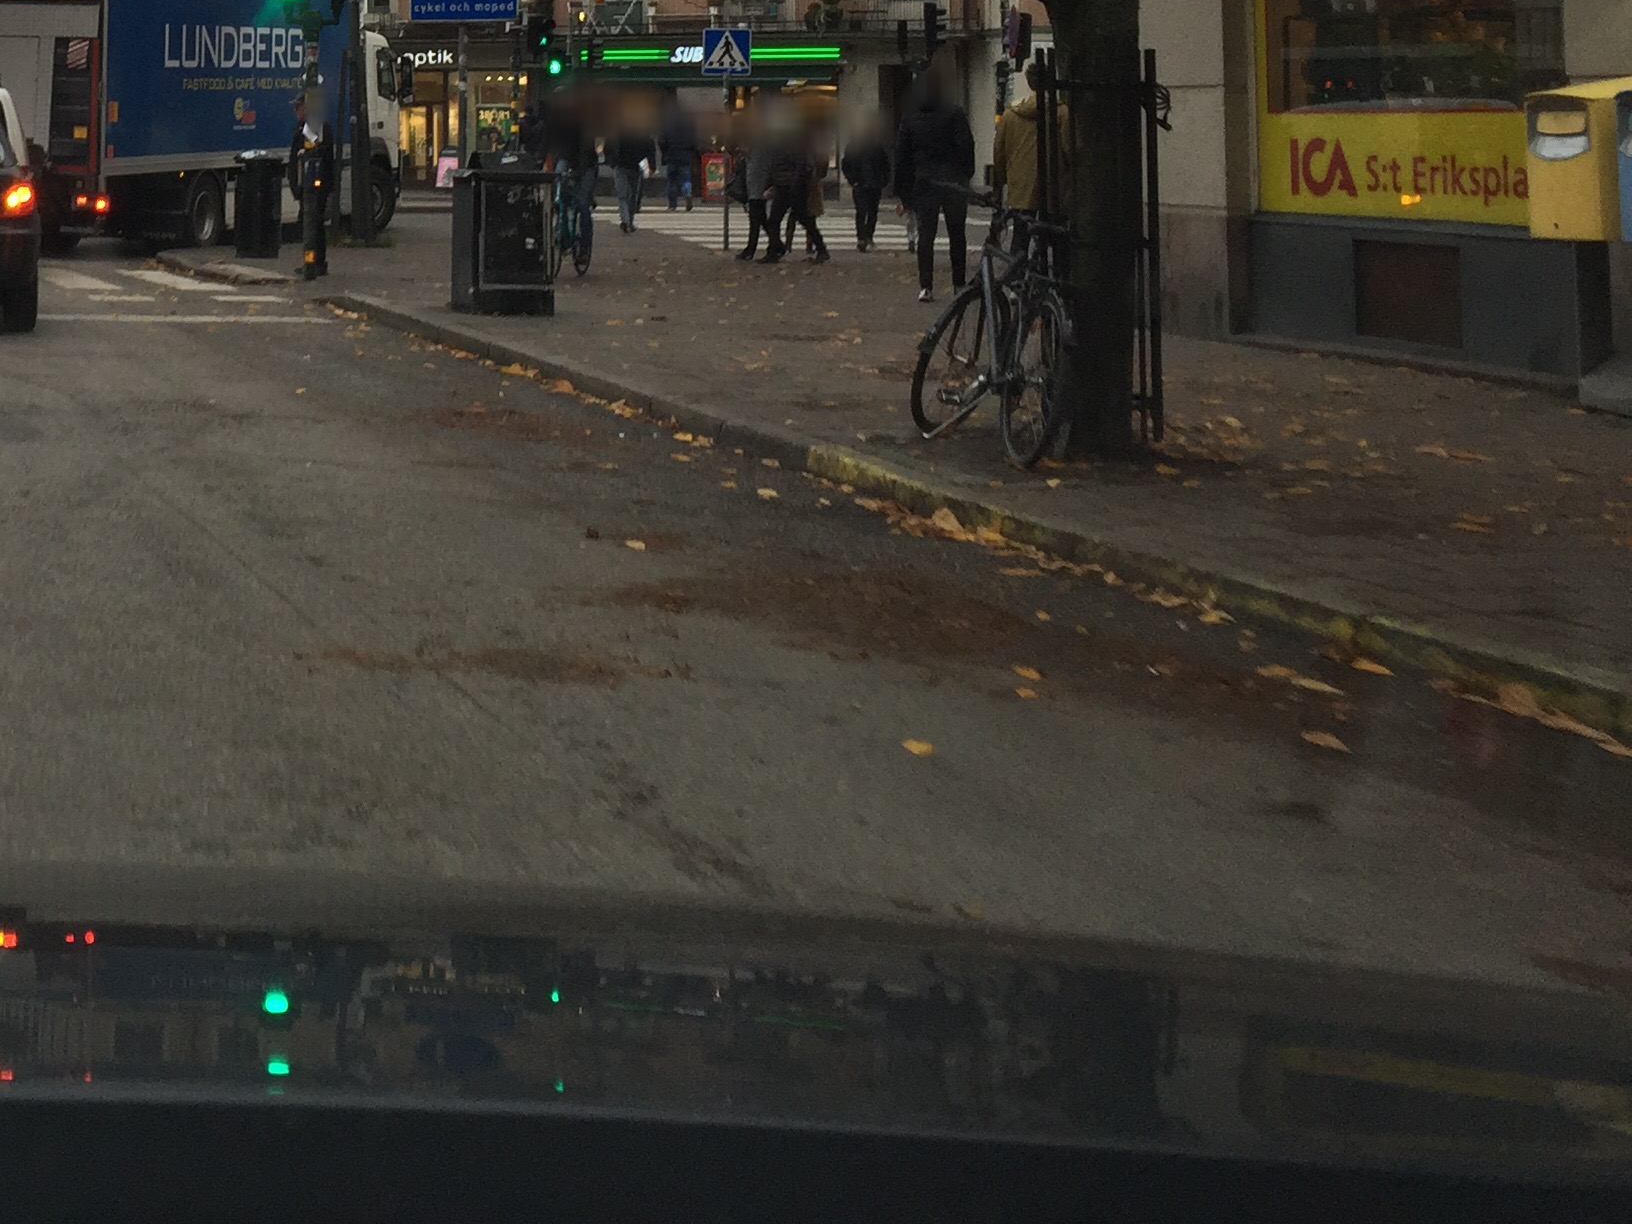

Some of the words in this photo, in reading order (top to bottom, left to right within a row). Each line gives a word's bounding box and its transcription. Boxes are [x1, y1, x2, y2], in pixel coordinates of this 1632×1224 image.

[413, 2, 446, 15] cykel
[449, 1, 470, 13] och
[474, 0, 515, 14] moped
[164, 23, 304, 69] LUNDBERG
[1290, 137, 1359, 198] ICA
[1366, 154, 1403, 194] S:t
